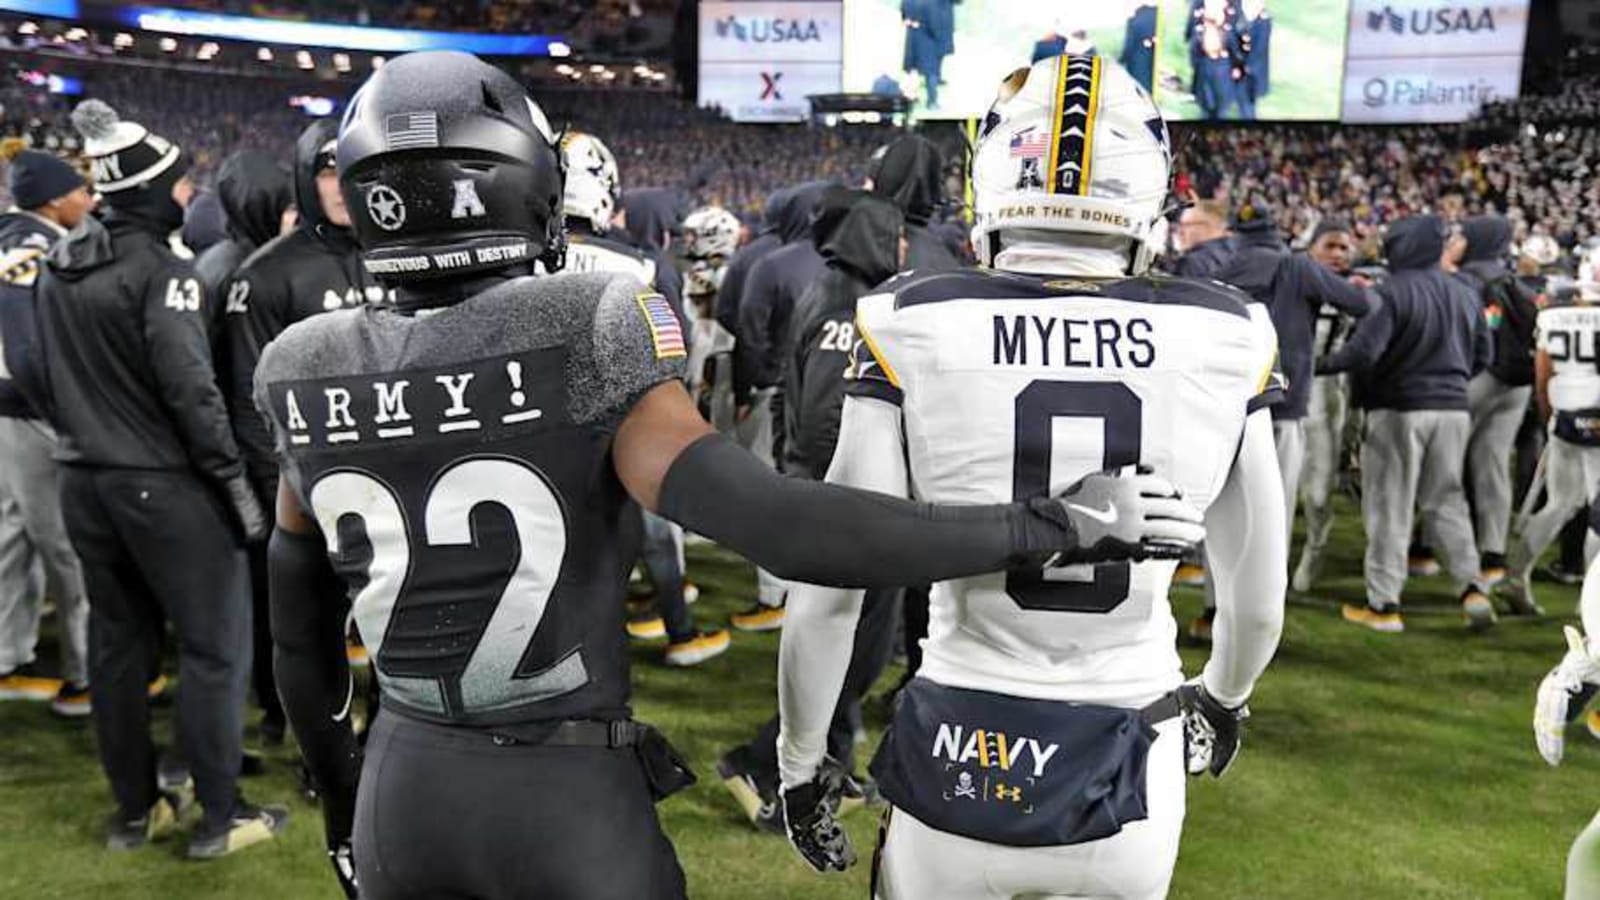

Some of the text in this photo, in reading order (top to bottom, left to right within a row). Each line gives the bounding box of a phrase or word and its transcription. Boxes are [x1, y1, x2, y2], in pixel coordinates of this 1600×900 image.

[751, 19, 821, 42] USAA
[1411, 8, 1495, 35] USAA
[1000, 205, 1131, 228] FEAR THE BONES
[433, 250, 471, 269] WITH
[476, 243, 527, 263] DESTINY
[165, 278, 199, 312] 43
[820, 320, 853, 352] 28
[993, 315, 1155, 368] MYERS
[1006, 379, 1142, 613] 0
[309, 455, 589, 715] 22
[932, 723, 1059, 776] NAVY
